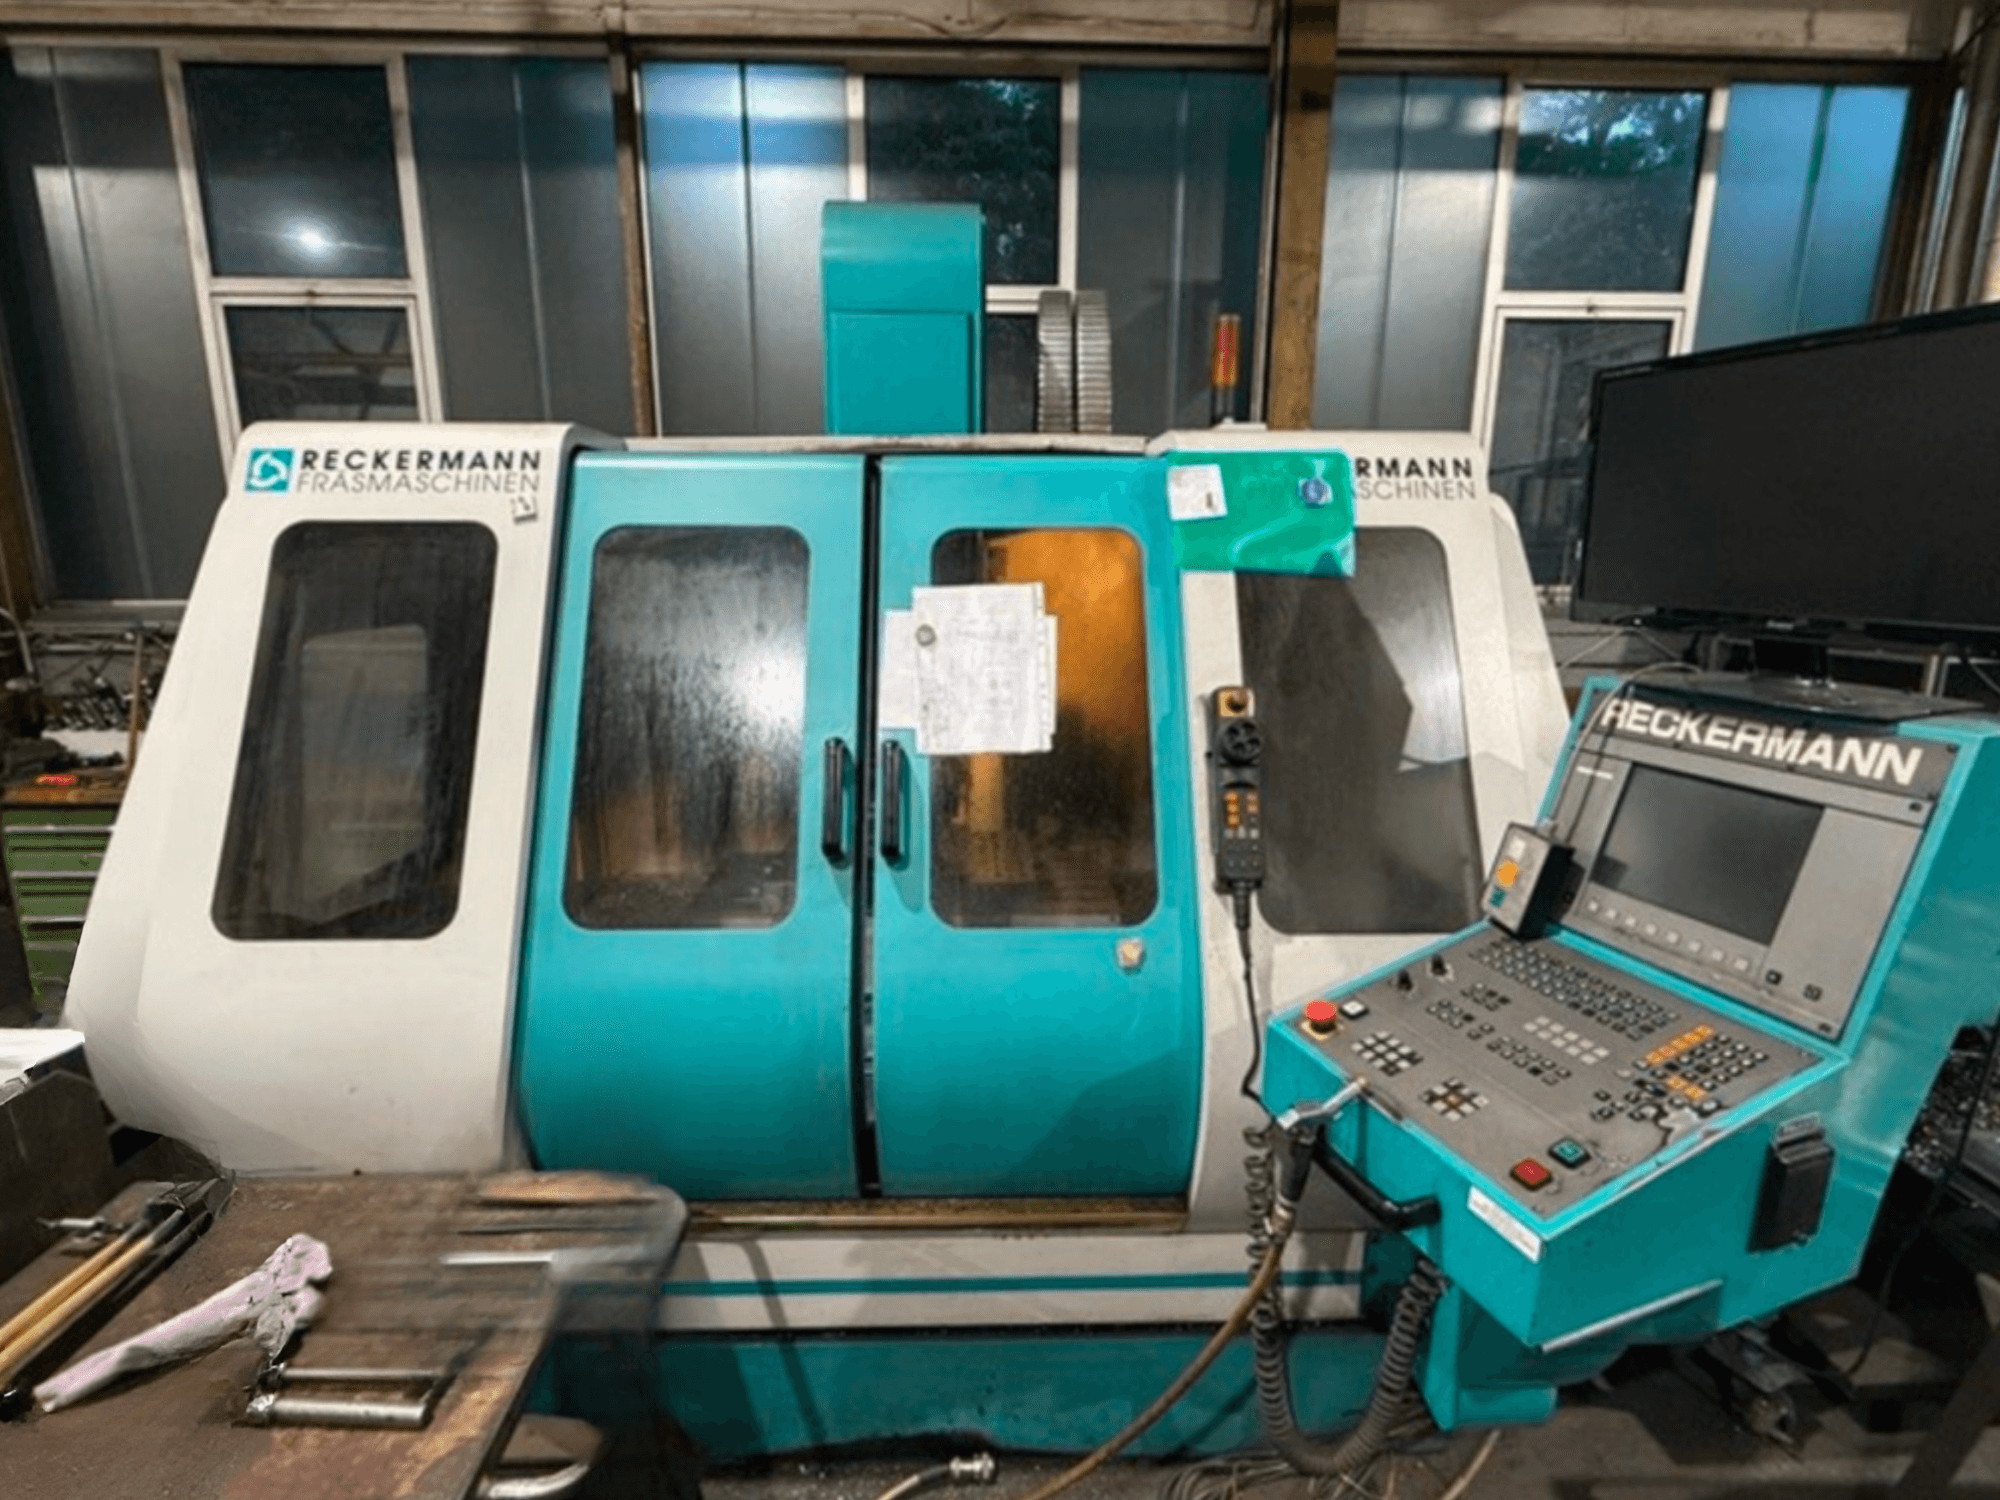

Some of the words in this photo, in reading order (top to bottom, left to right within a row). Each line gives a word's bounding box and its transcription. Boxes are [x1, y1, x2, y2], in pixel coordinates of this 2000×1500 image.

[301, 449, 541, 471] RECKERMANN
[1353, 480, 1476, 500] SCHINEN
[1601, 698, 1923, 785] RECKERMANN
